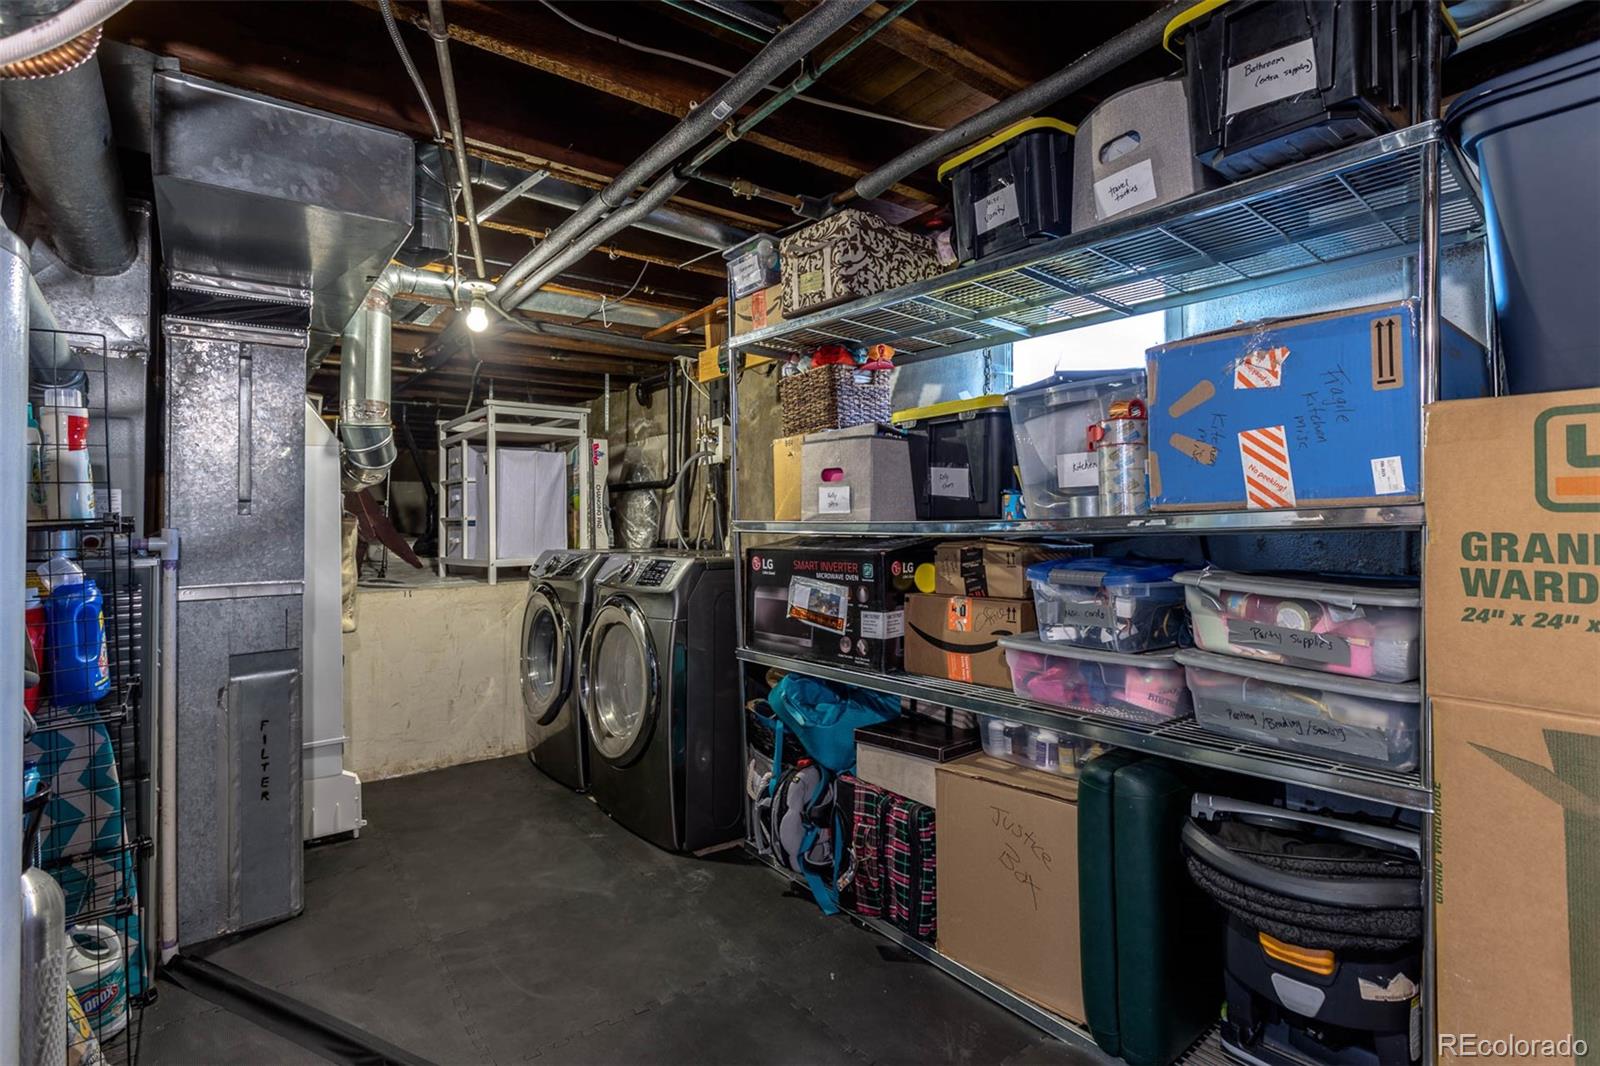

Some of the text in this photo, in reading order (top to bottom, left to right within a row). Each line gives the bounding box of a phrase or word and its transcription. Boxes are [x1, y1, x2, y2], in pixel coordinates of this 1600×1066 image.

[1248, 463, 1288, 492] No peeking!
[1460, 531, 1600, 566] GRAN
[762, 558, 774, 570] LG
[793, 560, 859, 573] SMART INVERTER
[902, 562, 914, 573] LG
[816, 572, 844, 581] MICROWAVE
[845, 574, 859, 582] OVEN
[1249, 627, 1281, 644] Party
[260, 719, 270, 801] FILTER
